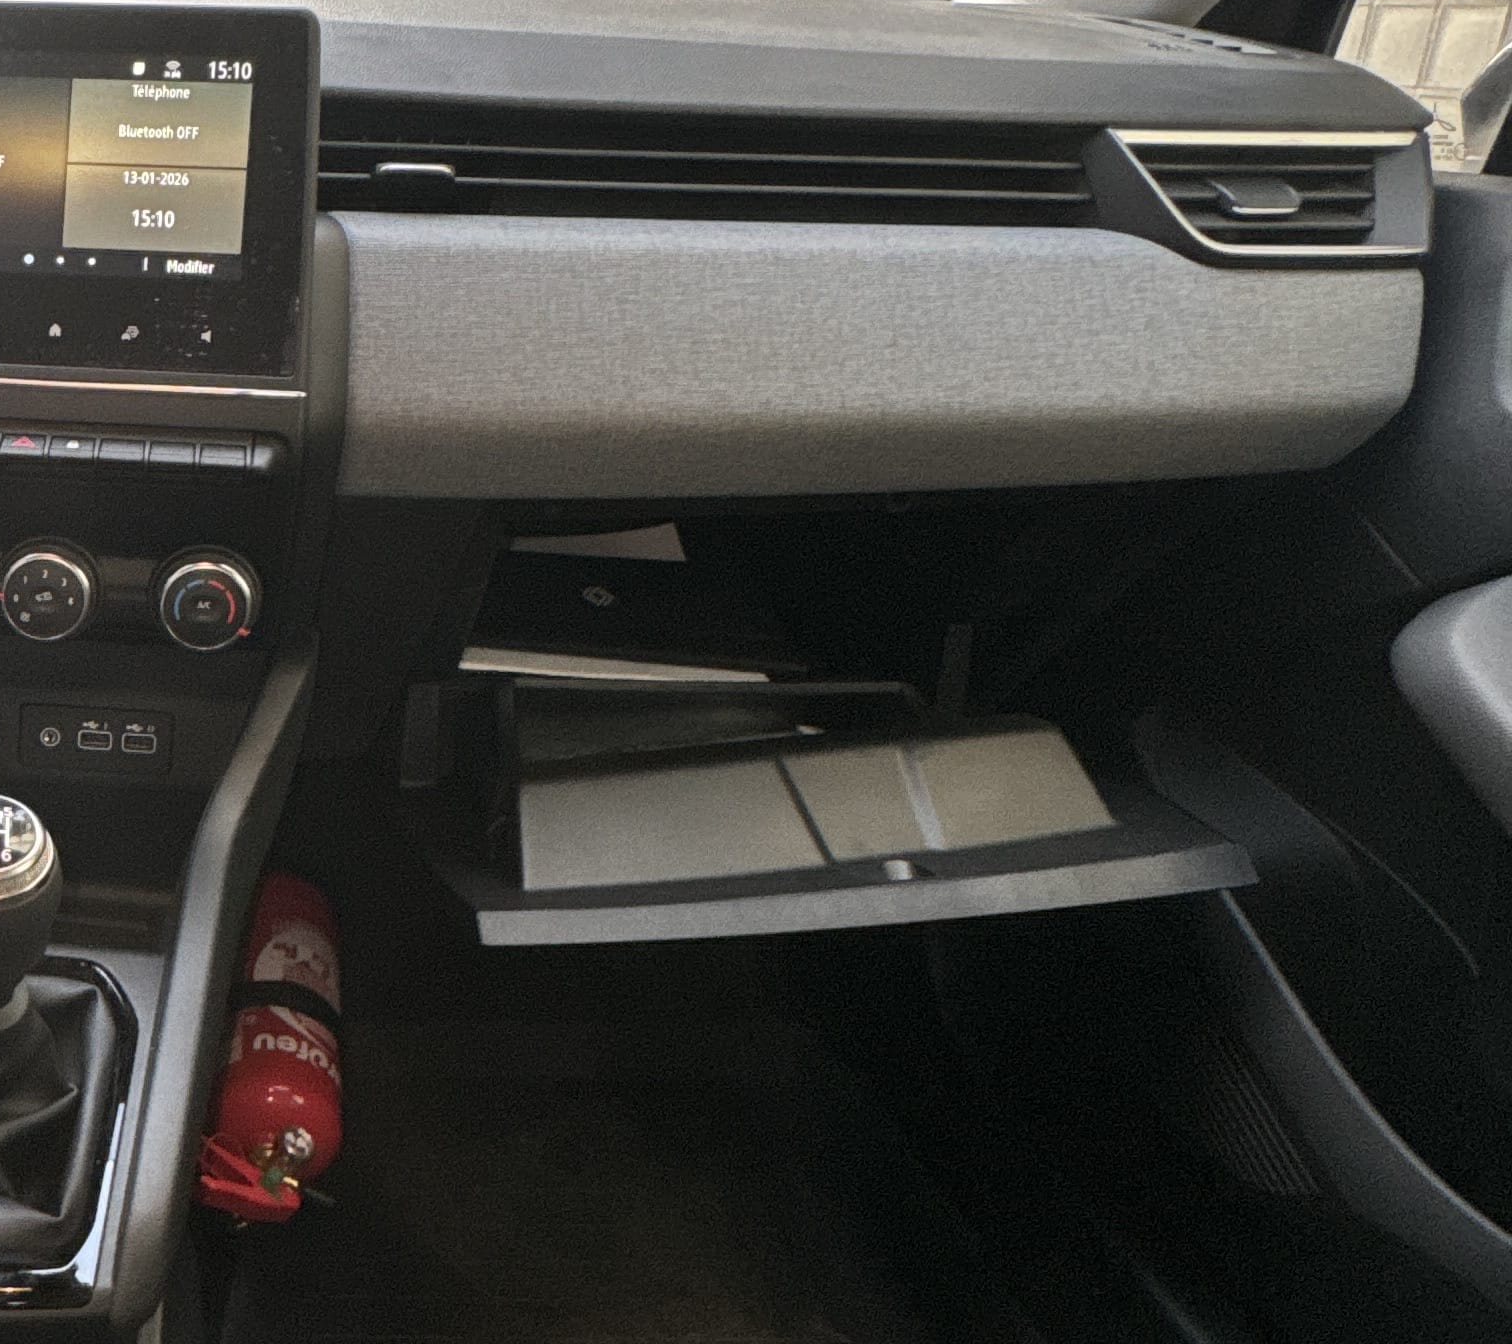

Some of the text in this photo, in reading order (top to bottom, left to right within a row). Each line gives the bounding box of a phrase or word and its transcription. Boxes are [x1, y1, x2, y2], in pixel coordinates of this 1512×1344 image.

[208, 60, 252, 80] 15:10
[132, 84, 190, 101] Téléphone
[118, 123, 199, 140] Bluetooth OFF
[123, 170, 189, 186] 13-01-2026
[131, 209, 175, 228] 15:10
[166, 259, 215, 275] Modifier
[1, 847, 13, 863] 6
